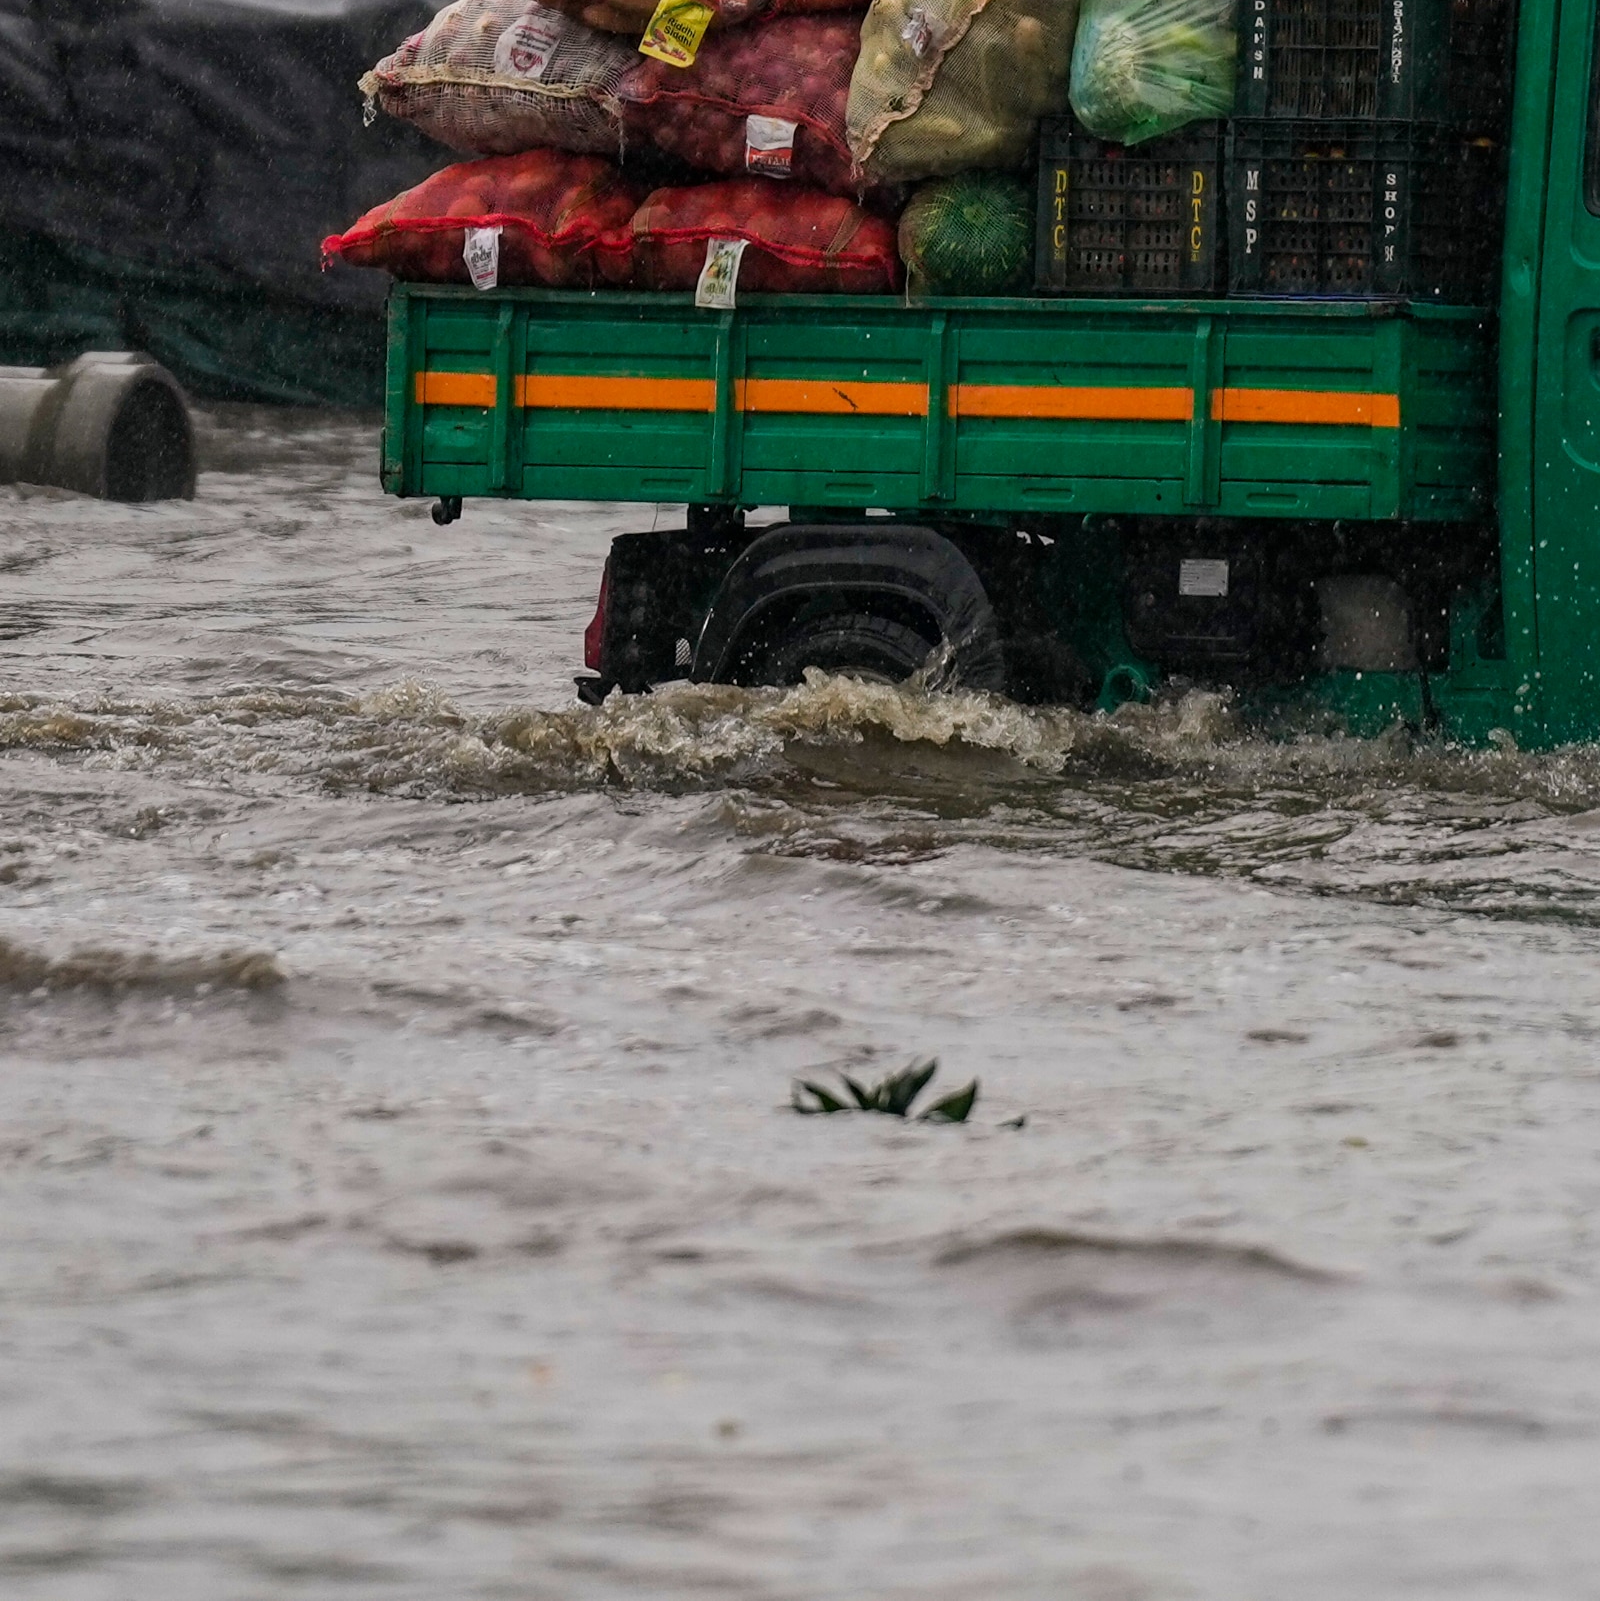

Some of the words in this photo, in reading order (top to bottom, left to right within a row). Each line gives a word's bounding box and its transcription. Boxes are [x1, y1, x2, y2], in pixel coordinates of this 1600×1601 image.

[663, 25, 693, 47] Siddhi
[666, 17, 697, 39] Riddhi
[1054, 170, 1068, 248] DTC
[1190, 171, 1204, 249] DTC
[1246, 171, 1259, 254] MSP
